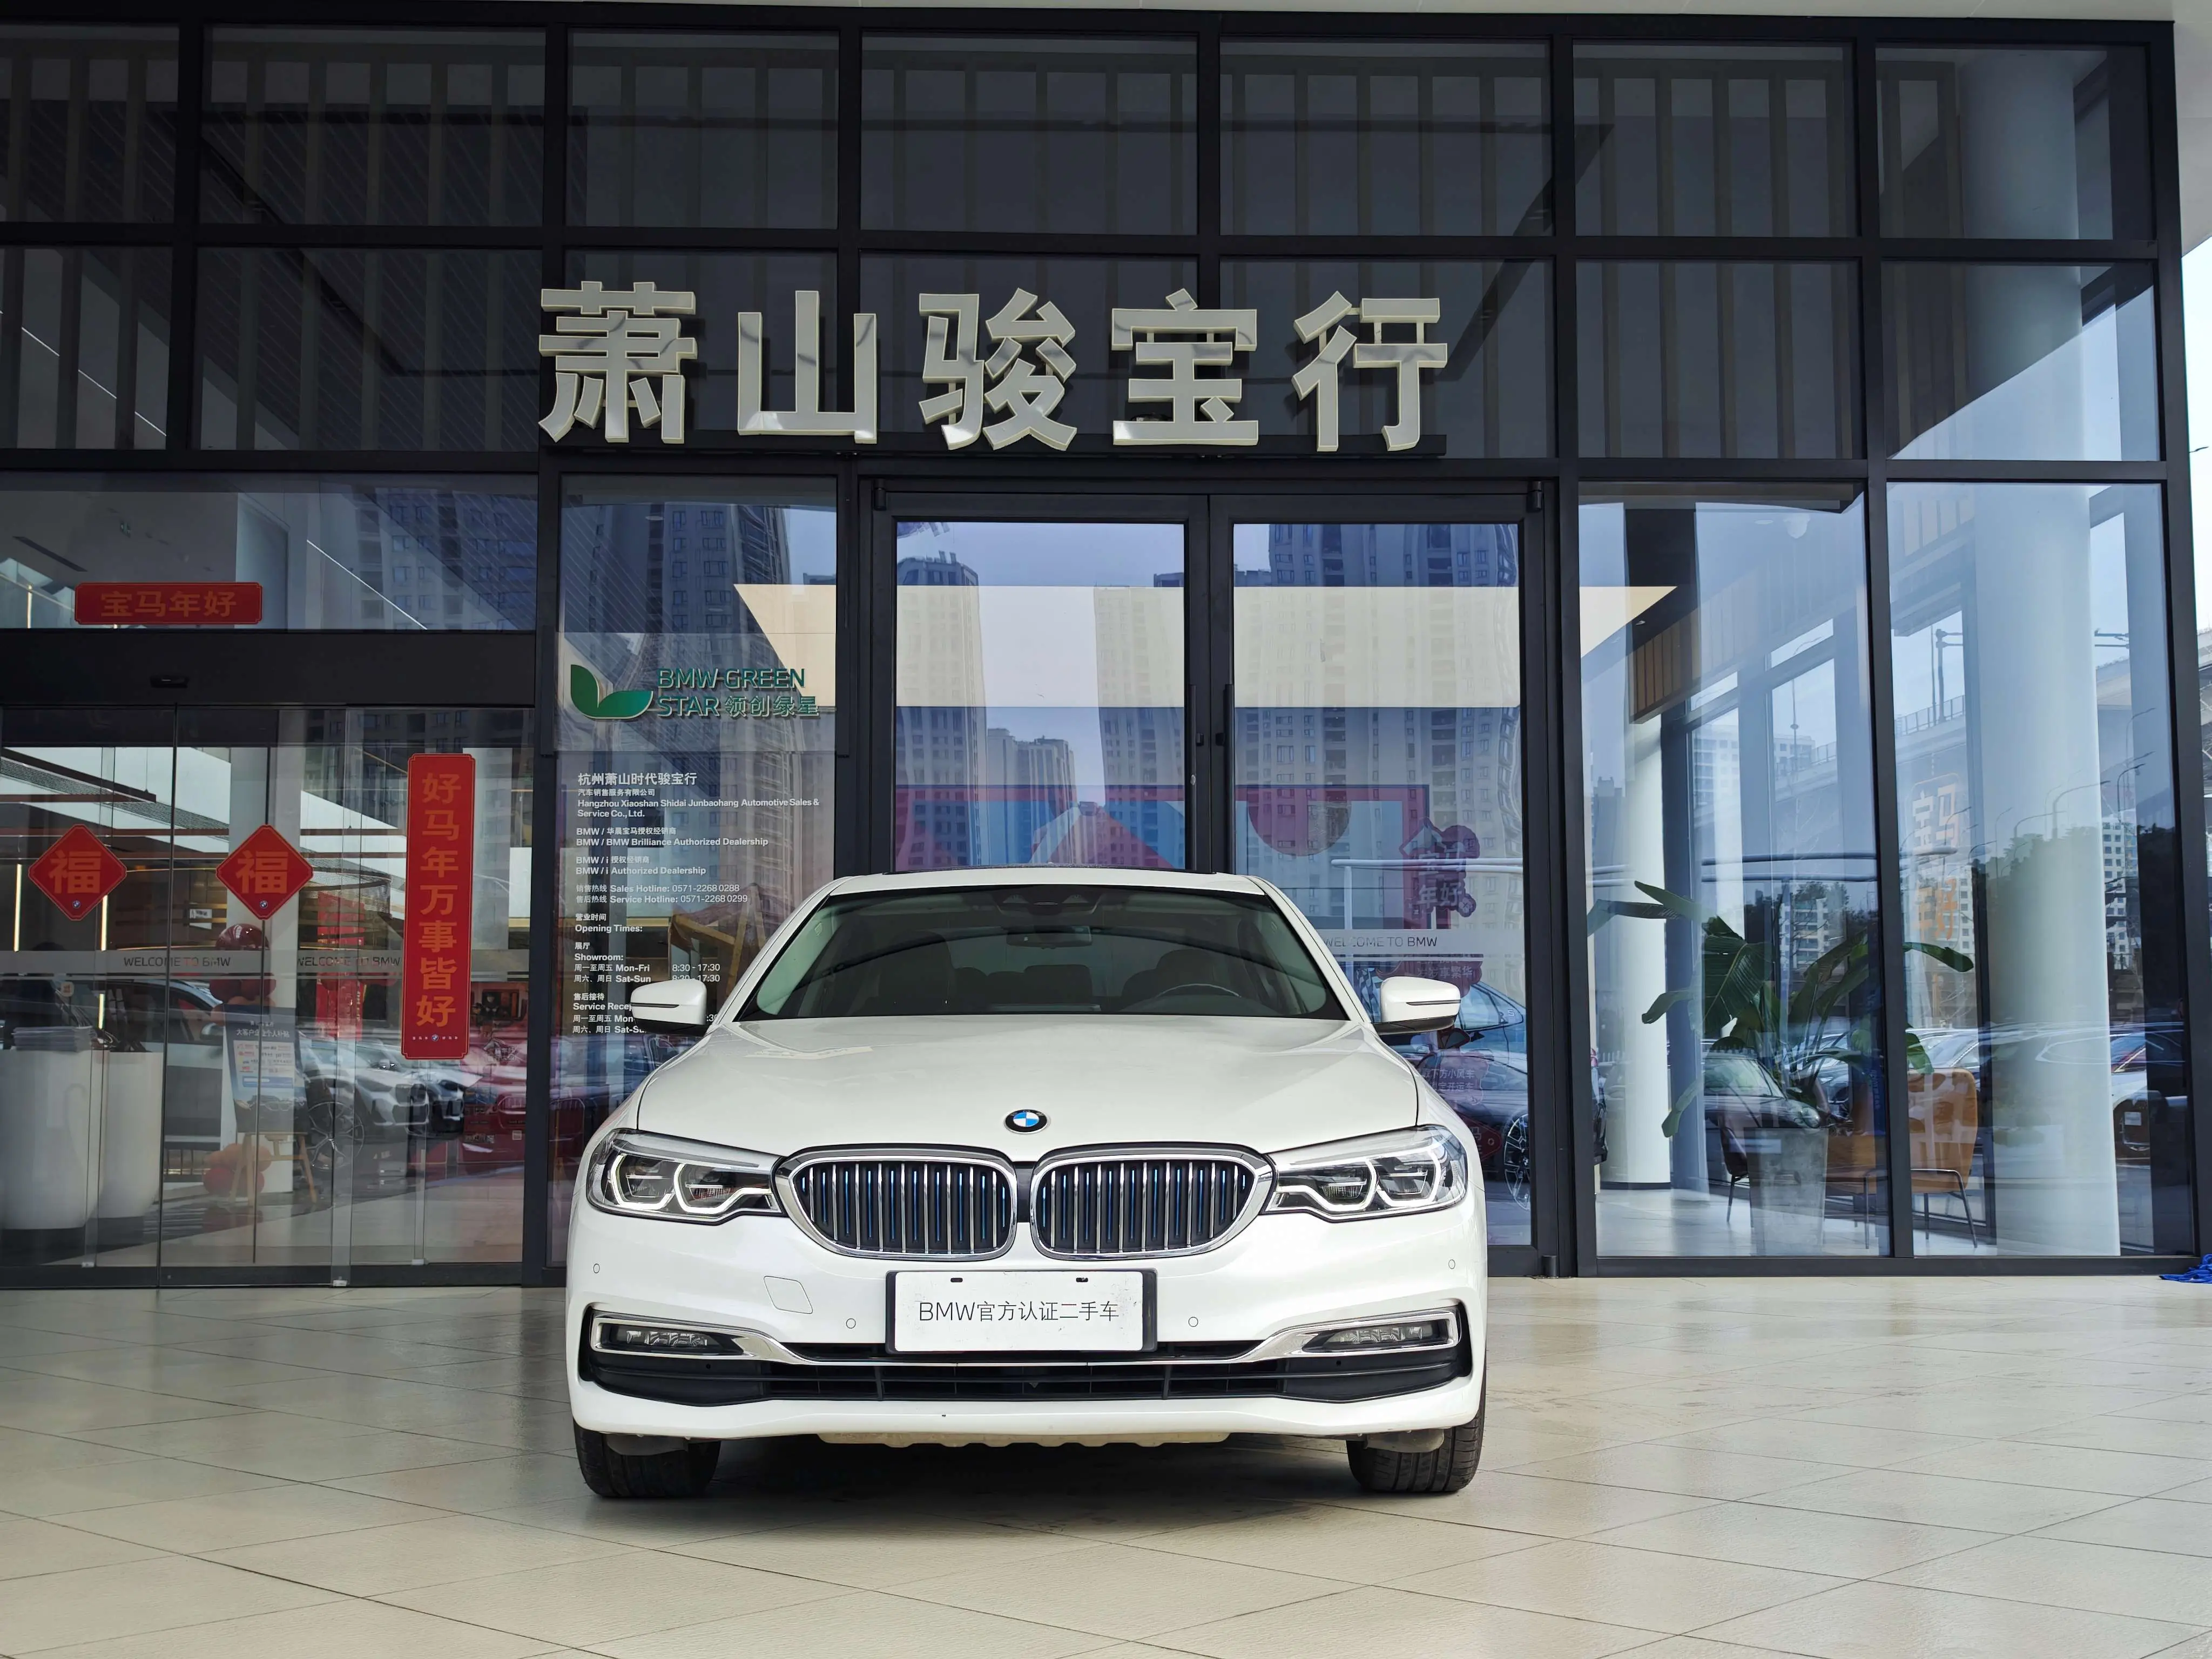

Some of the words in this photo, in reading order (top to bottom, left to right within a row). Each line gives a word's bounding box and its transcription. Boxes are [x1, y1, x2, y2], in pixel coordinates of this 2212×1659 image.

[538, 281, 1447, 451] 萧山骏宝行
[101, 590, 237, 617] 宝马年好
[658, 668, 718, 689] BMW
[725, 668, 805, 689] GREEN
[657, 696, 719, 717] STAR
[724, 696, 820, 717] 领创绿星
[578, 773, 697, 785] 杭州萧山时代骏宝行
[578, 800, 619, 808] Hangzhou
[688, 799, 739, 808] Junbaohang
[741, 798, 788, 806] Automotive
[790, 798, 812, 806] Sales
[631, 838, 672, 846] Brilliance
[673, 838, 720, 846] Authorized
[723, 838, 768, 847] Dealership
[49, 851, 102, 894] 福
[235, 851, 288, 894] 福
[660, 867, 706, 875] Dealership
[416, 773, 461, 1028] 好马年万事皆好
[575, 913, 606, 921] 营业时间
[575, 925, 611, 933] Opening
[575, 942, 590, 950] 展厅
[1387, 937, 1403, 947] TO
[1407, 936, 1438, 947] BMW
[183, 957, 199, 967] TO
[203, 957, 231, 967] BMW
[698, 963, 720, 972] 17:30
[574, 975, 612, 983] 周六、周日
[573, 993, 604, 1001] 售后接待
[572, 1015, 611, 1023] 周一至周五
[572, 1026, 611, 1034] 周六、周日
[920, 1301, 1119, 1321] BMW官方认证二手车
